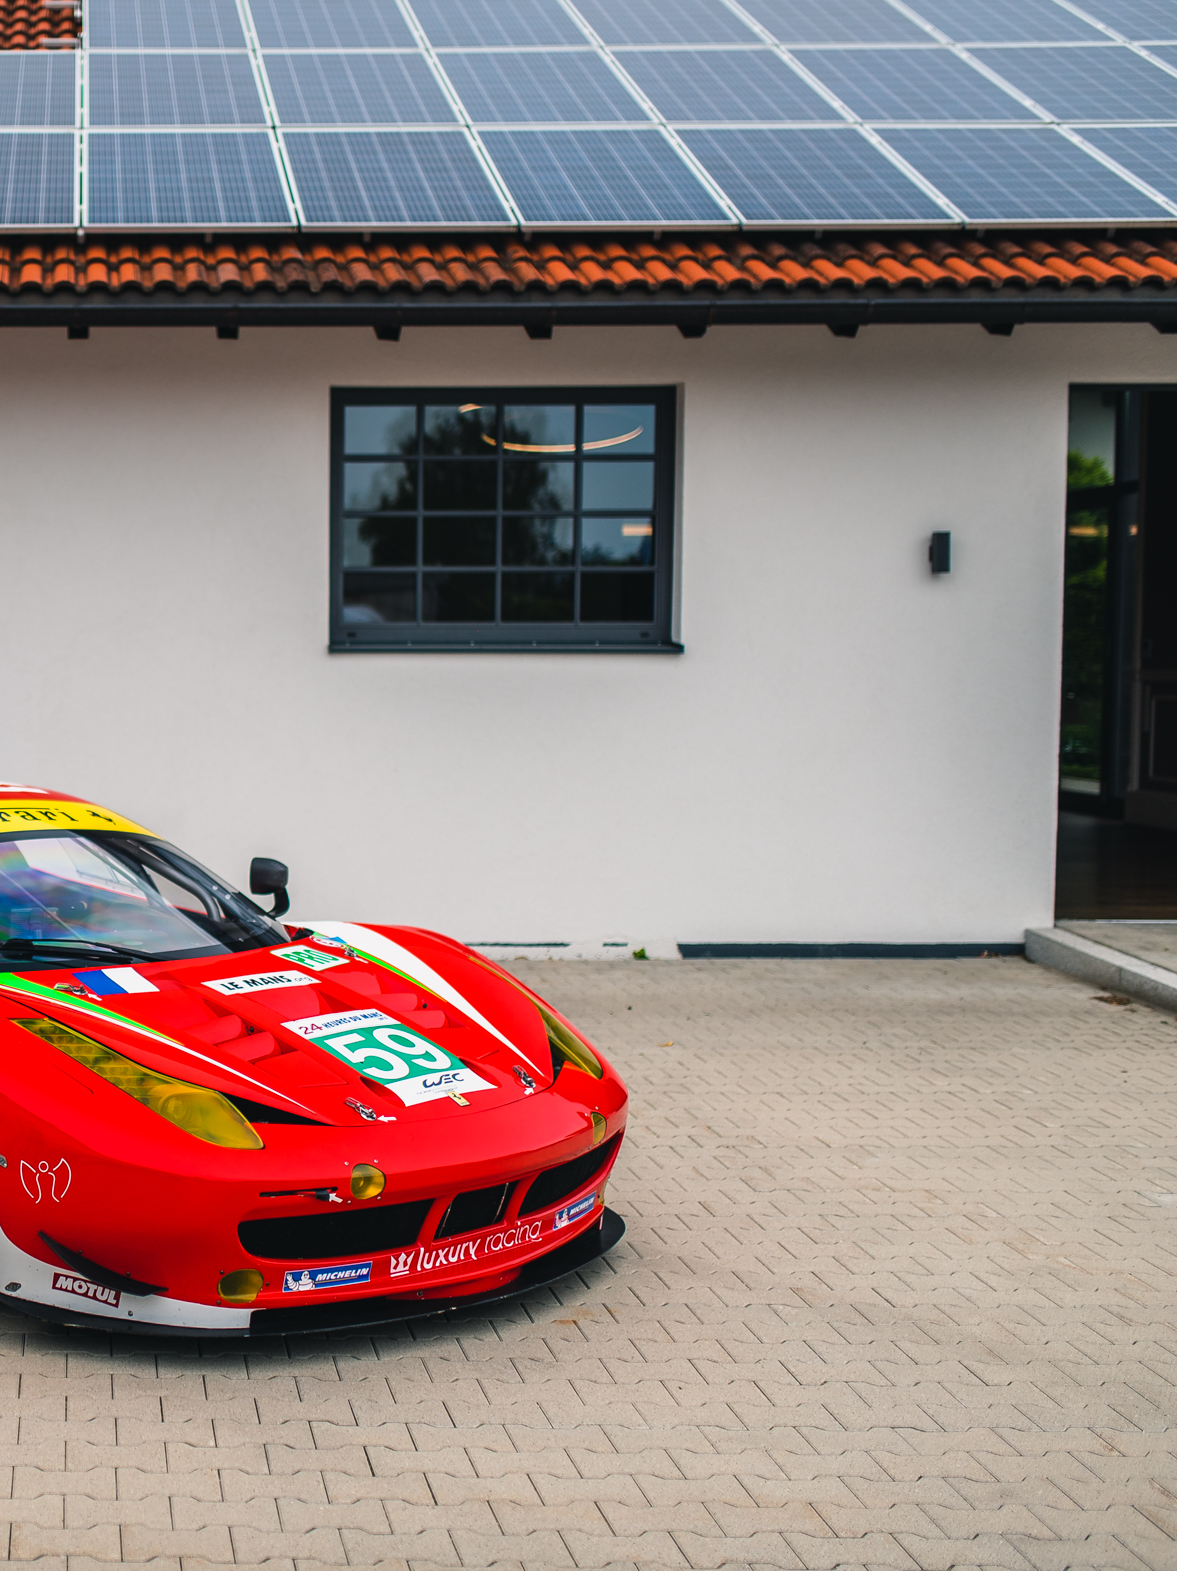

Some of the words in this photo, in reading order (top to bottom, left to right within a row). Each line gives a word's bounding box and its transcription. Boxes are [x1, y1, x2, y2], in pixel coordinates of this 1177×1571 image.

[280, 949, 340, 968] PRO
[220, 981, 244, 991] LE
[299, 1023, 323, 1035] 24
[321, 1017, 351, 1029] HEURES
[323, 1027, 452, 1080] 59
[422, 1072, 464, 1088] WEC
[417, 1247, 481, 1271] luxury
[484, 1220, 543, 1253] racing
[315, 1267, 370, 1282] MICHELIN
[55, 1276, 117, 1305] MOTUL
